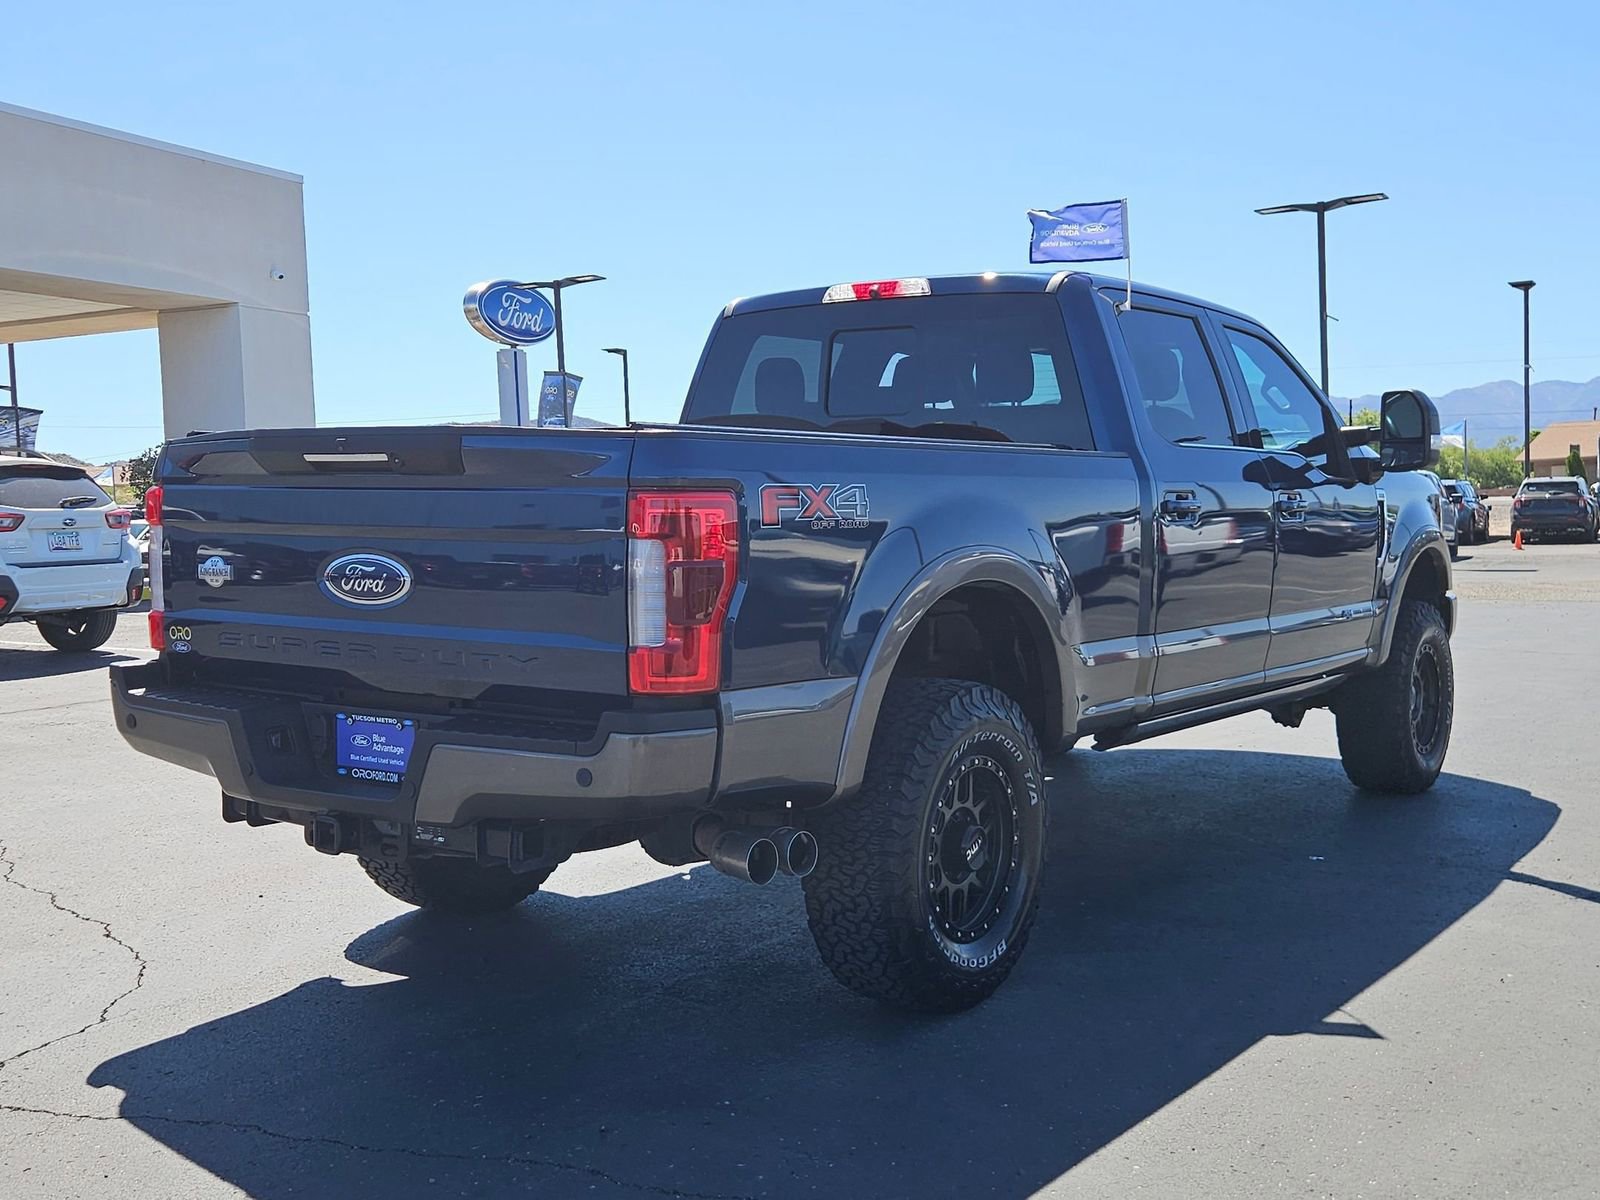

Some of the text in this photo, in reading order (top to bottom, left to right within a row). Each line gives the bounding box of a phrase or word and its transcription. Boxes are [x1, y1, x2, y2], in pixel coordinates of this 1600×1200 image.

[498, 291, 544, 332] Ford
[759, 484, 869, 528] FX4
[811, 519, 869, 529] OFF ROAD
[341, 564, 387, 592] Ford
[169, 626, 192, 640] ORO
[217, 631, 542, 672] SUPER DUTY
[351, 714, 376, 722] TUCSON
[353, 735, 368, 745] Ford
[372, 734, 386, 743] Blue
[372, 743, 405, 755] Advantage
[360, 755, 377, 763] Certified
[351, 768, 399, 782] OROFORD.COM
[1023, 768, 1039, 806] T/A
